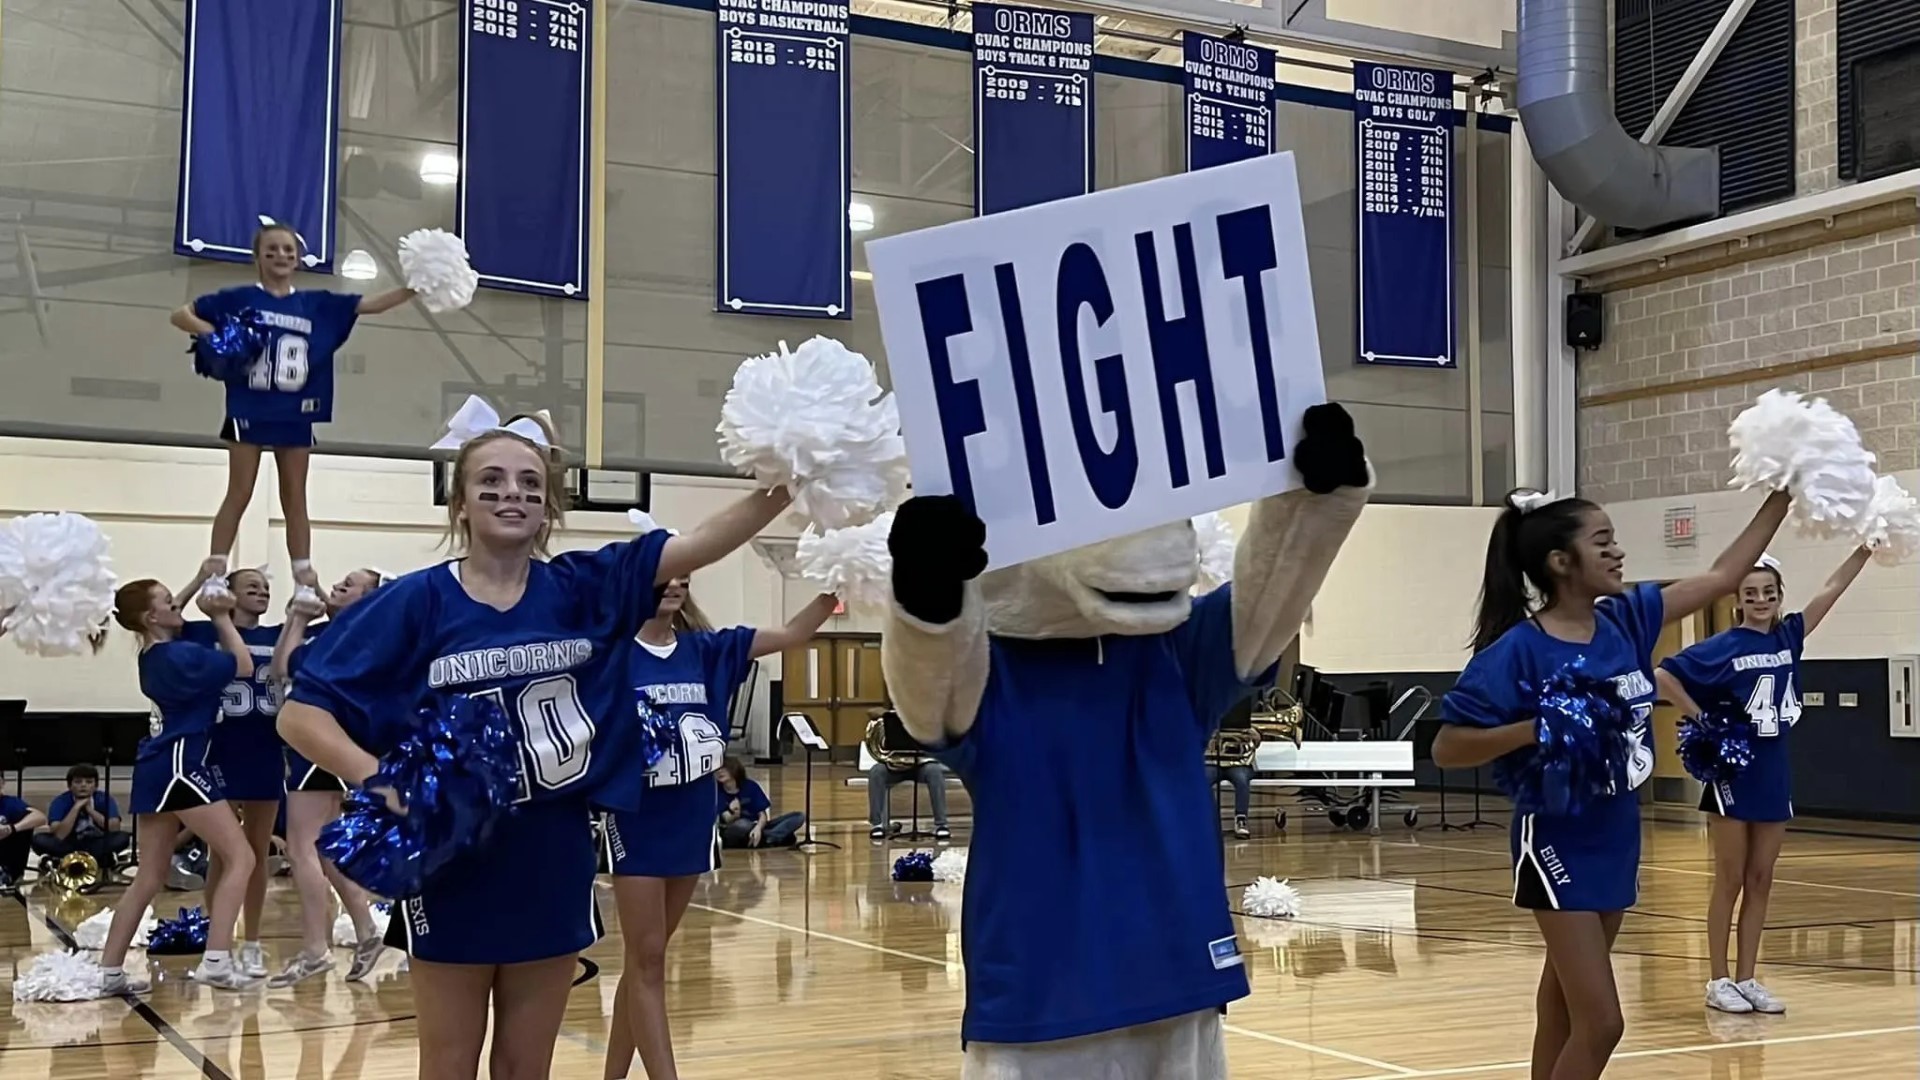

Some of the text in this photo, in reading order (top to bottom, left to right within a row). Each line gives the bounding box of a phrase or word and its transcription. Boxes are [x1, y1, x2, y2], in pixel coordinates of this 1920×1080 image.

[549, 10, 577, 25] 7th
[761, 0, 848, 19] CHAMPIONS
[473, 7, 517, 25] 2012
[549, 23, 577, 38] 7th
[719, 10, 849, 34] BOYS BASKETBALL
[996, 9, 1071, 38] ORMS
[473, 20, 517, 38] 2013
[549, 36, 577, 51] 7th
[975, 33, 1092, 56] GVAC CHAMPIONS
[731, 40, 775, 53] 2012
[806, 47, 835, 59] 8th
[731, 52, 775, 65] 2019
[977, 49, 1090, 70] BOYS TRACK & FIELD
[1201, 39, 1258, 71] ORMS
[987, 77, 1028, 89] 2009
[1054, 83, 1080, 94] 7th
[1185, 61, 1274, 90] GVAC CHAMPIONS
[1372, 67, 1434, 94] ORMS
[986, 88, 1026, 100] 2019
[1054, 95, 1081, 106] 7th
[1194, 77, 1265, 101] BOYS TENNIS
[1356, 89, 1452, 109] GVAC CHAMPIONS
[1193, 104, 1221, 116] 2011
[1373, 106, 1436, 122] BOYS GOLF
[1193, 114, 1224, 128] 2012
[1246, 124, 1265, 136] 7th
[1193, 125, 1224, 139] 2012
[1365, 129, 1400, 140] 2009
[1421, 135, 1443, 145] 7th
[1365, 140, 1398, 151] 2010
[1421, 145, 1443, 155] 7th
[1365, 150, 1395, 160] 2011
[1421, 156, 1443, 165] 7th
[1365, 161, 1395, 171] 2011
[1421, 166, 1443, 176] 8th
[1365, 171, 1398, 182] 2012
[1421, 177, 1443, 186] 8th
[1365, 182, 1398, 192] 2013
[1421, 187, 1443, 197] 7th
[1365, 192, 1398, 203] 2014
[1421, 197, 1443, 207] 8th
[1366, 203, 1398, 213] 2017
[1412, 207, 1444, 217] 7/8th
[915, 204, 1285, 526] FIGHT
[428, 638, 592, 688] UNICORNS
[220, 663, 286, 716] 53
[1744, 672, 1802, 736] 44
[608, 813, 626, 862] SUMMER
[1540, 845, 1571, 886] EMILY
